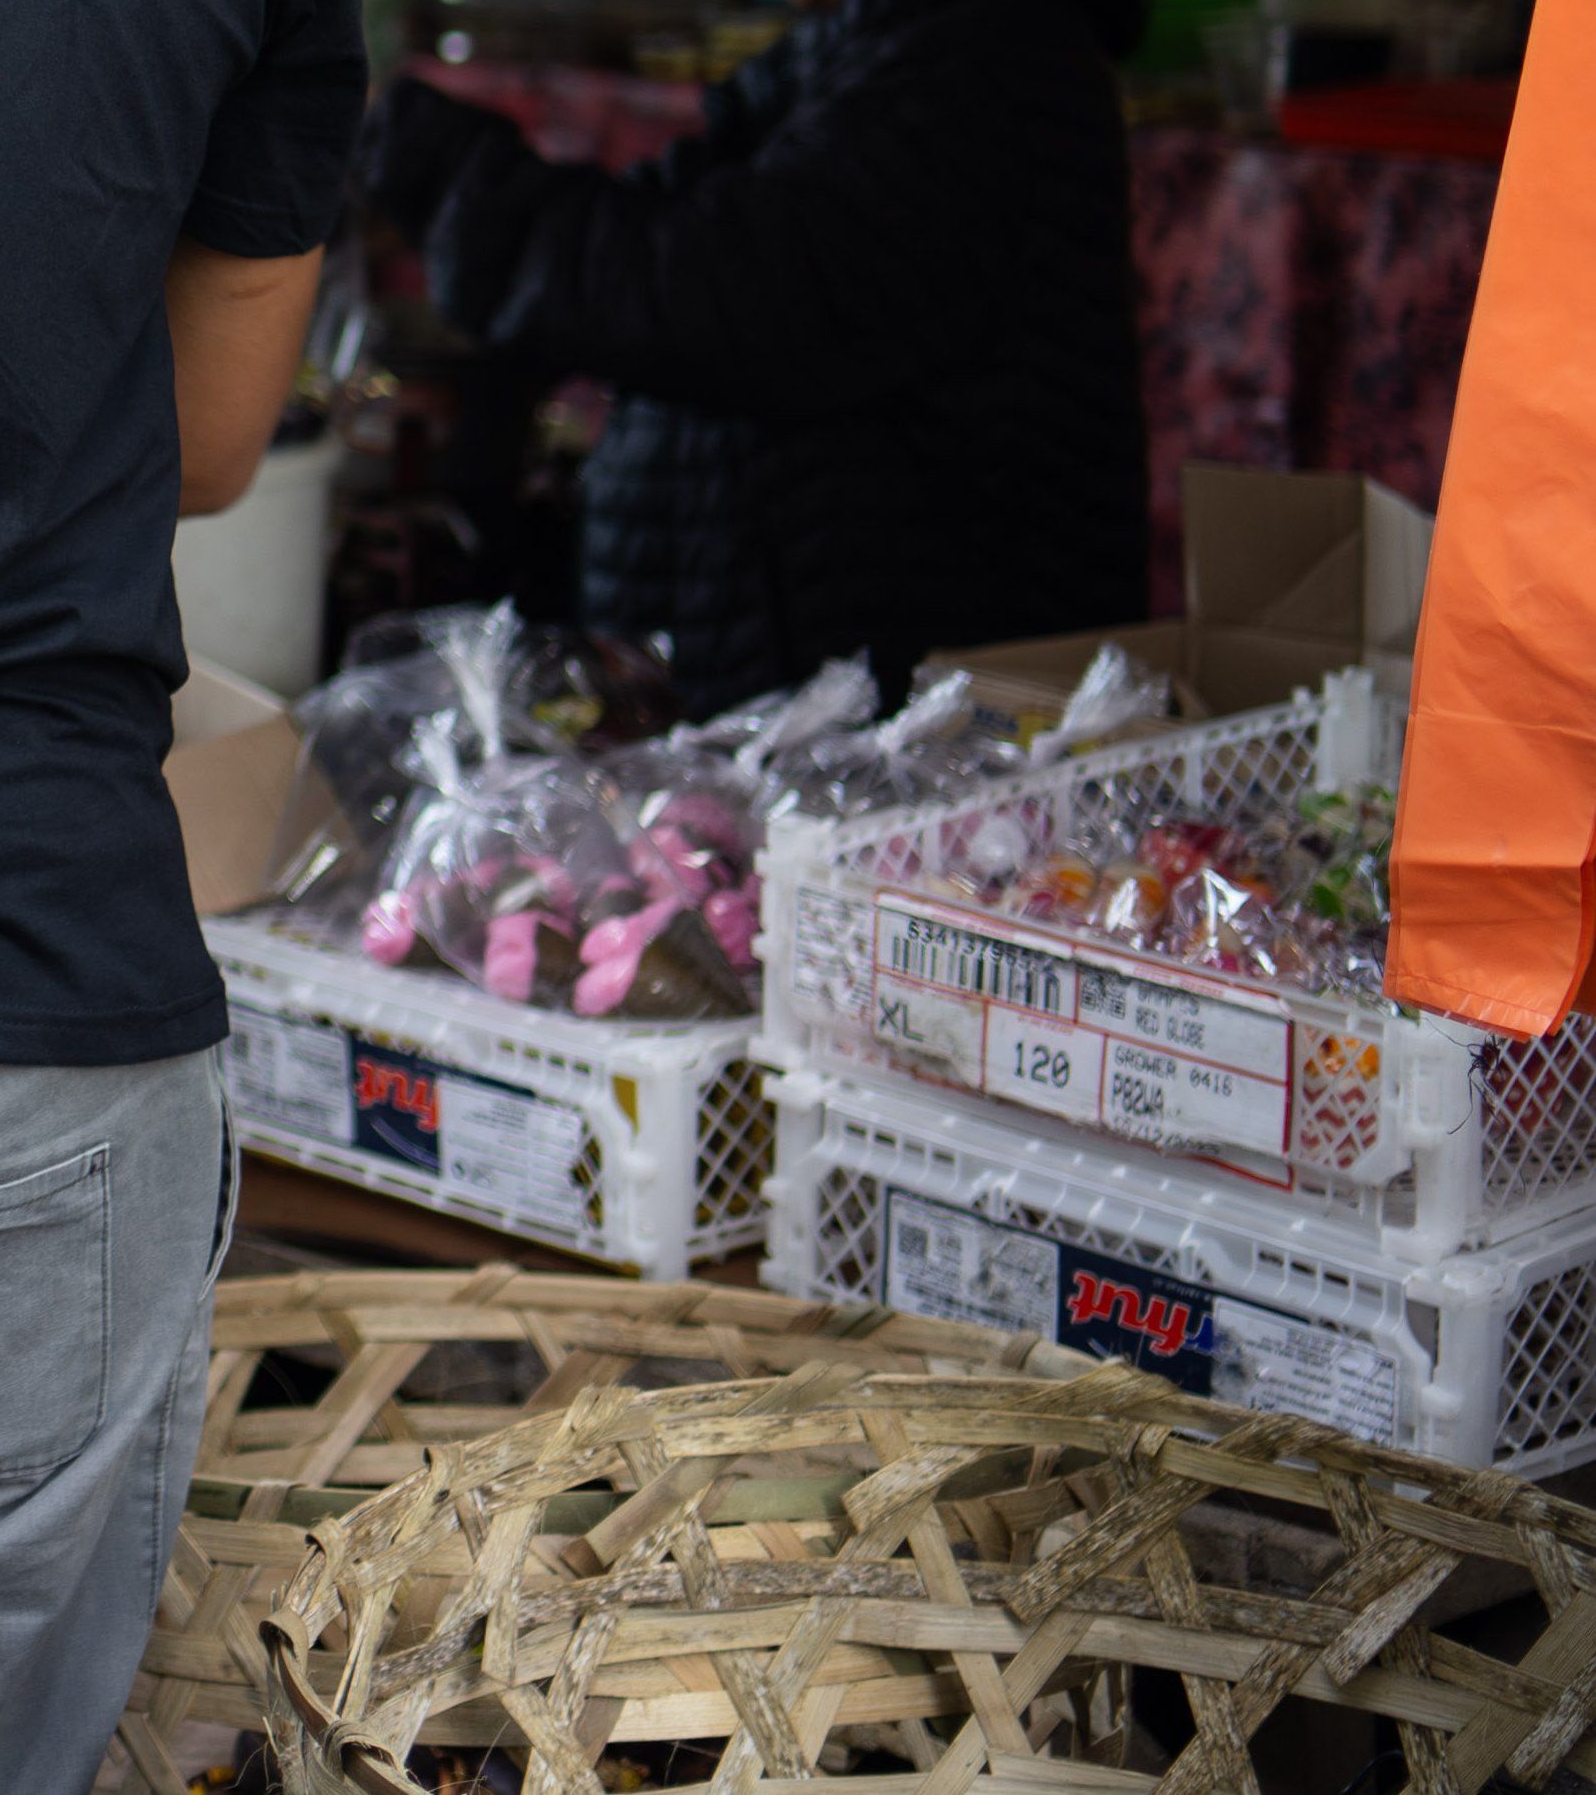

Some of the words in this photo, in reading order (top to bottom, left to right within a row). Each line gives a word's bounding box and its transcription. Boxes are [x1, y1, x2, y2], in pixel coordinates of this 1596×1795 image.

[879, 994, 924, 1042] XL
[1135, 1007, 1160, 1036] RED
[1166, 1013, 1206, 1051] GLOBE
[1013, 1037, 1070, 1088] 120
[1114, 1045, 1177, 1078] GROWER
